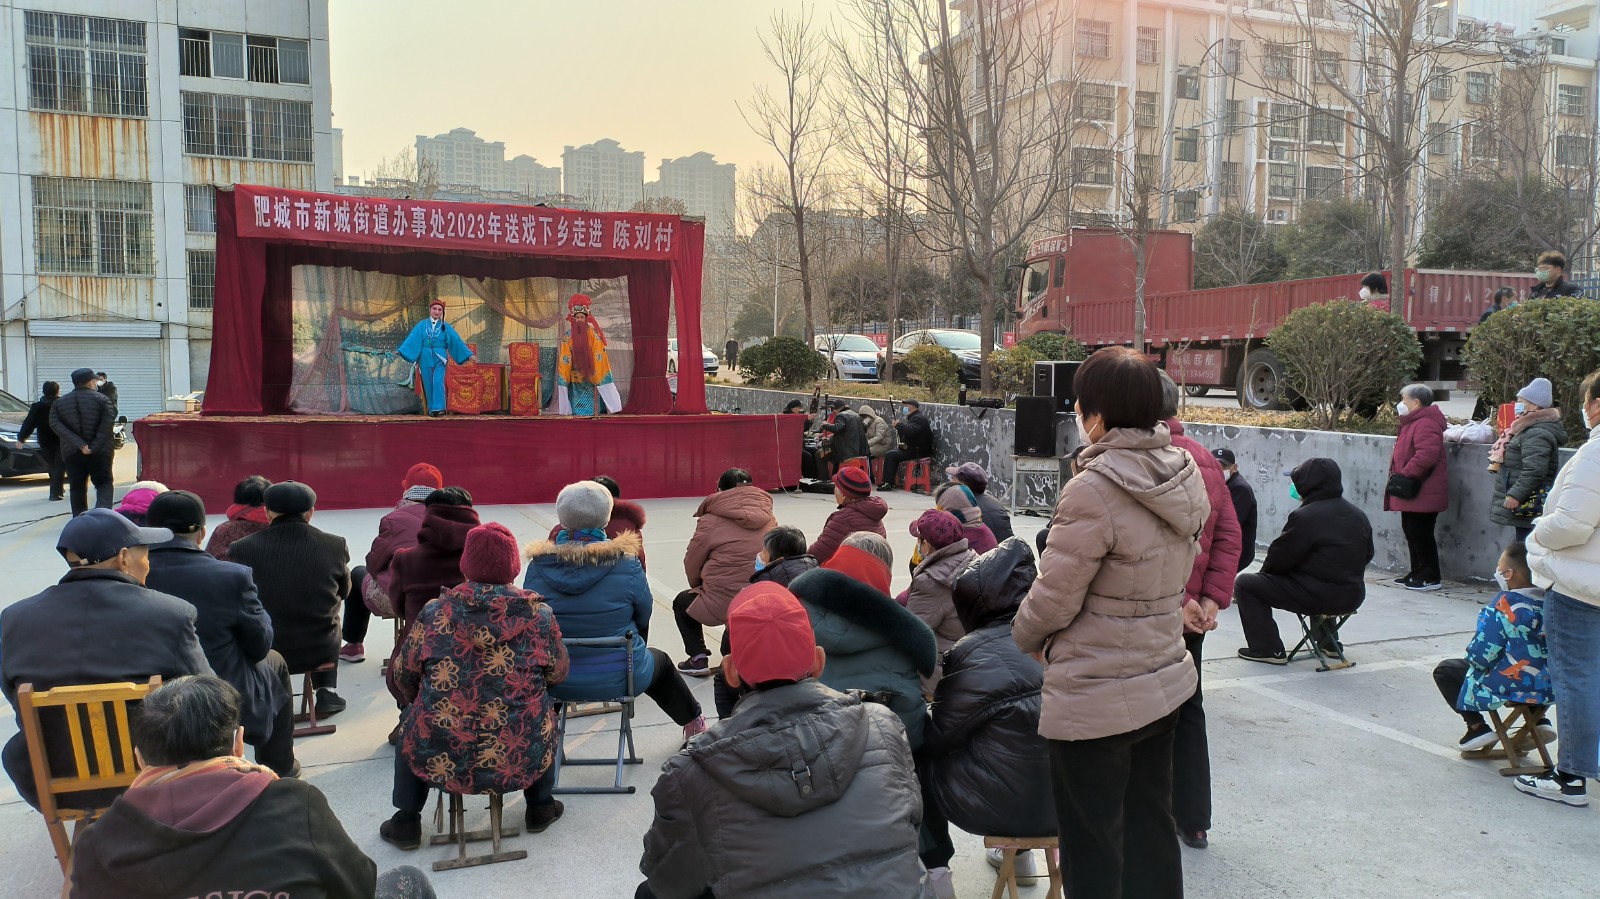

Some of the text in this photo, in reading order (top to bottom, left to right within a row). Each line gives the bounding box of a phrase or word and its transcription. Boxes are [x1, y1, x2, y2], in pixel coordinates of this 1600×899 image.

[253, 195, 674, 253] 肥城市新城街道办事处2023年送戏下乡走进 陈刘村
